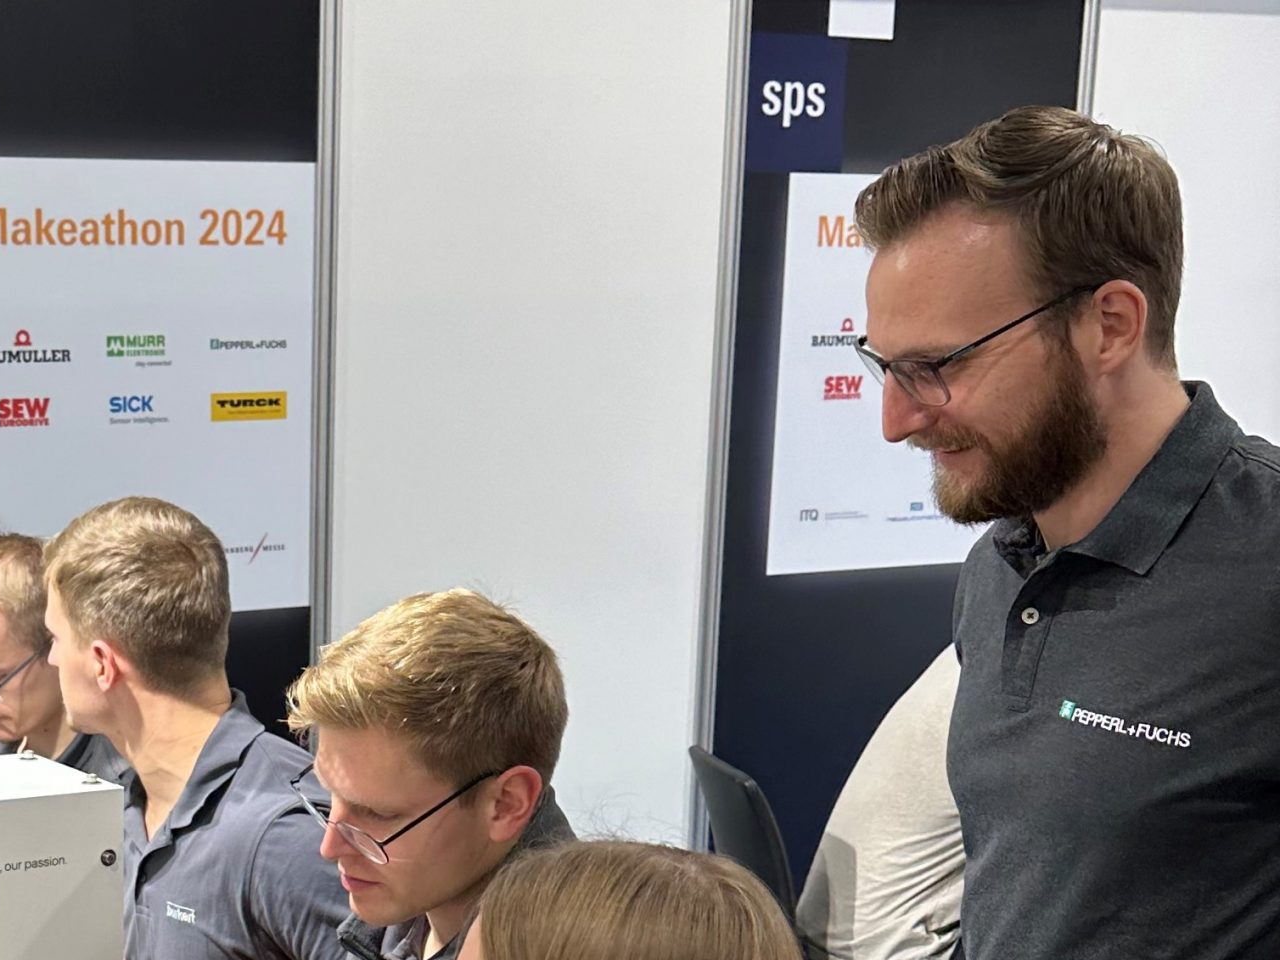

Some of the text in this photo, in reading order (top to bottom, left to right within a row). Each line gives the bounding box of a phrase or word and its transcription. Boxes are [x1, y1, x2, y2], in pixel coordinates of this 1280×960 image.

[761, 80, 826, 128] sps
[198, 209, 288, 246] 2024
[817, 215, 862, 248] Ma
[126, 335, 166, 348] MURR
[219, 339, 287, 351] PEPPERL+FUCHS
[824, 375, 864, 393] SEW
[109, 395, 154, 413] SICK
[217, 398, 282, 409] TURCK
[1072, 708, 1192, 748] PEPPERL+FUCHS
[4, 862, 22, 872] our
[24, 856, 68, 871] passion.
